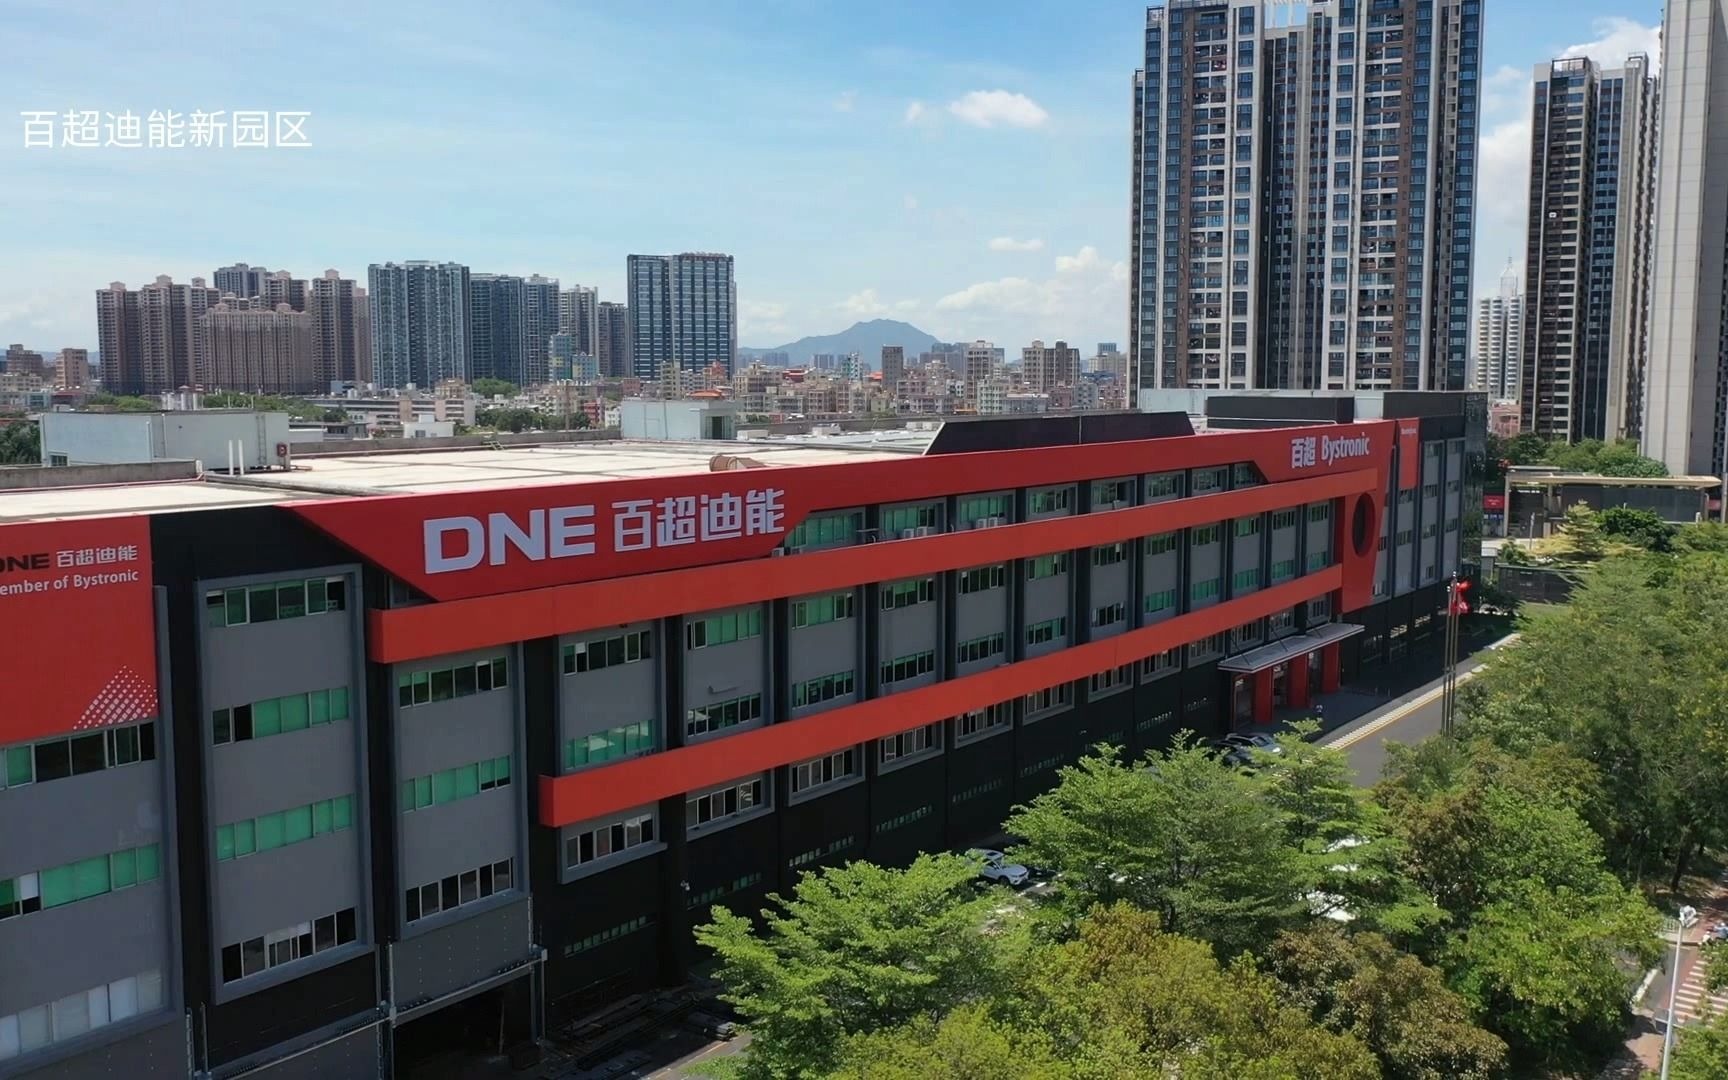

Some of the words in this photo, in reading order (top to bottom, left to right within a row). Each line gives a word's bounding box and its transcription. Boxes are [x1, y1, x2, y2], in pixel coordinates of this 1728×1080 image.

[1290, 437, 1316, 469] 百超
[1321, 432, 1370, 467] Bystronic
[423, 504, 596, 575] DNE
[611, 488, 785, 553] 百超迪能
[0, 553, 50, 572] NE
[56, 545, 138, 568] 百超迪能
[53, 575, 69, 590] of
[73, 569, 139, 589] Bystronic
